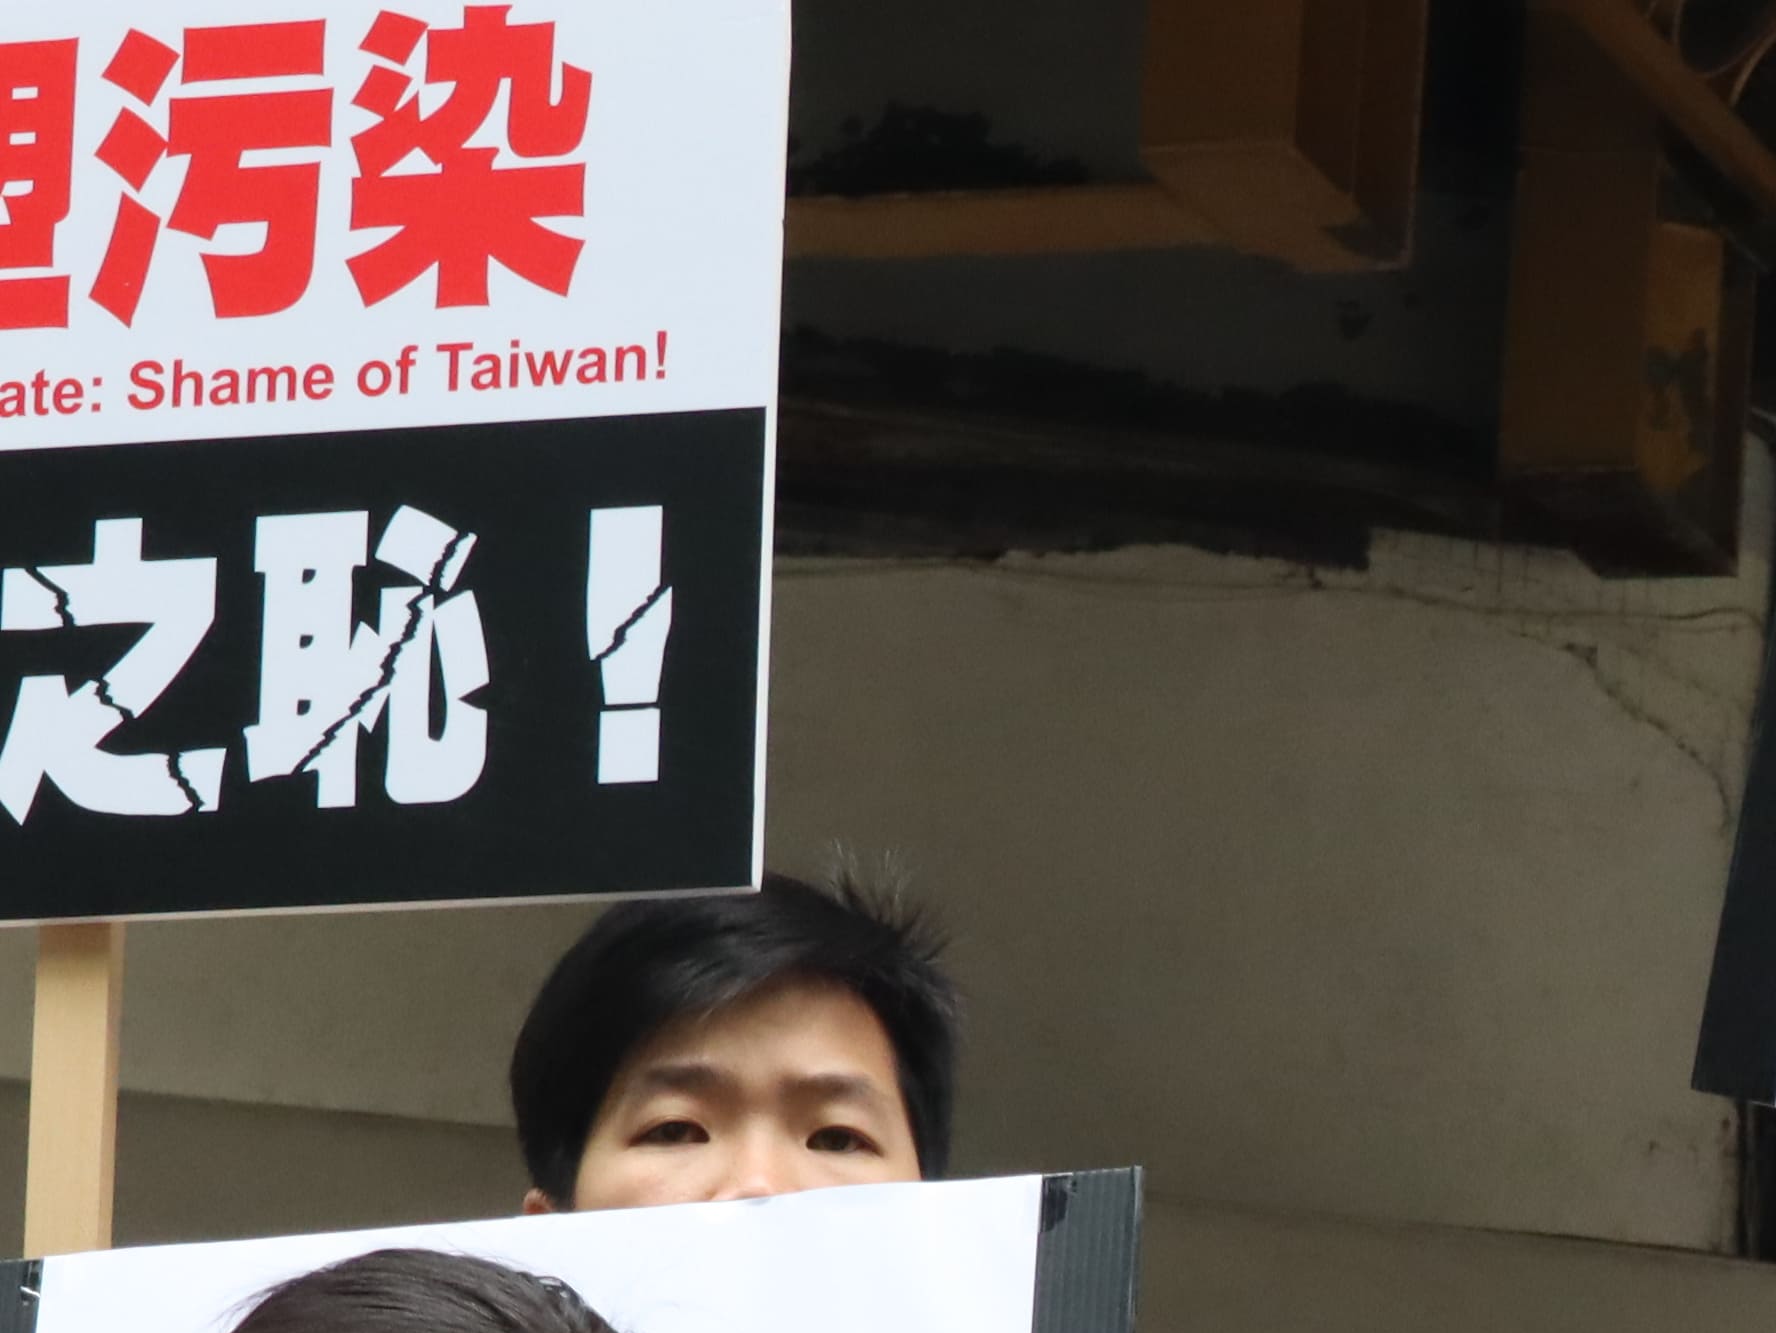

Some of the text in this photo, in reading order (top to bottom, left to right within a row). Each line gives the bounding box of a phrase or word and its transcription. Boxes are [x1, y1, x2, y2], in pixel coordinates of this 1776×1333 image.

[127, 357, 333, 412] Shame
[356, 344, 417, 398] of
[437, 330, 669, 393] Taiwan!
